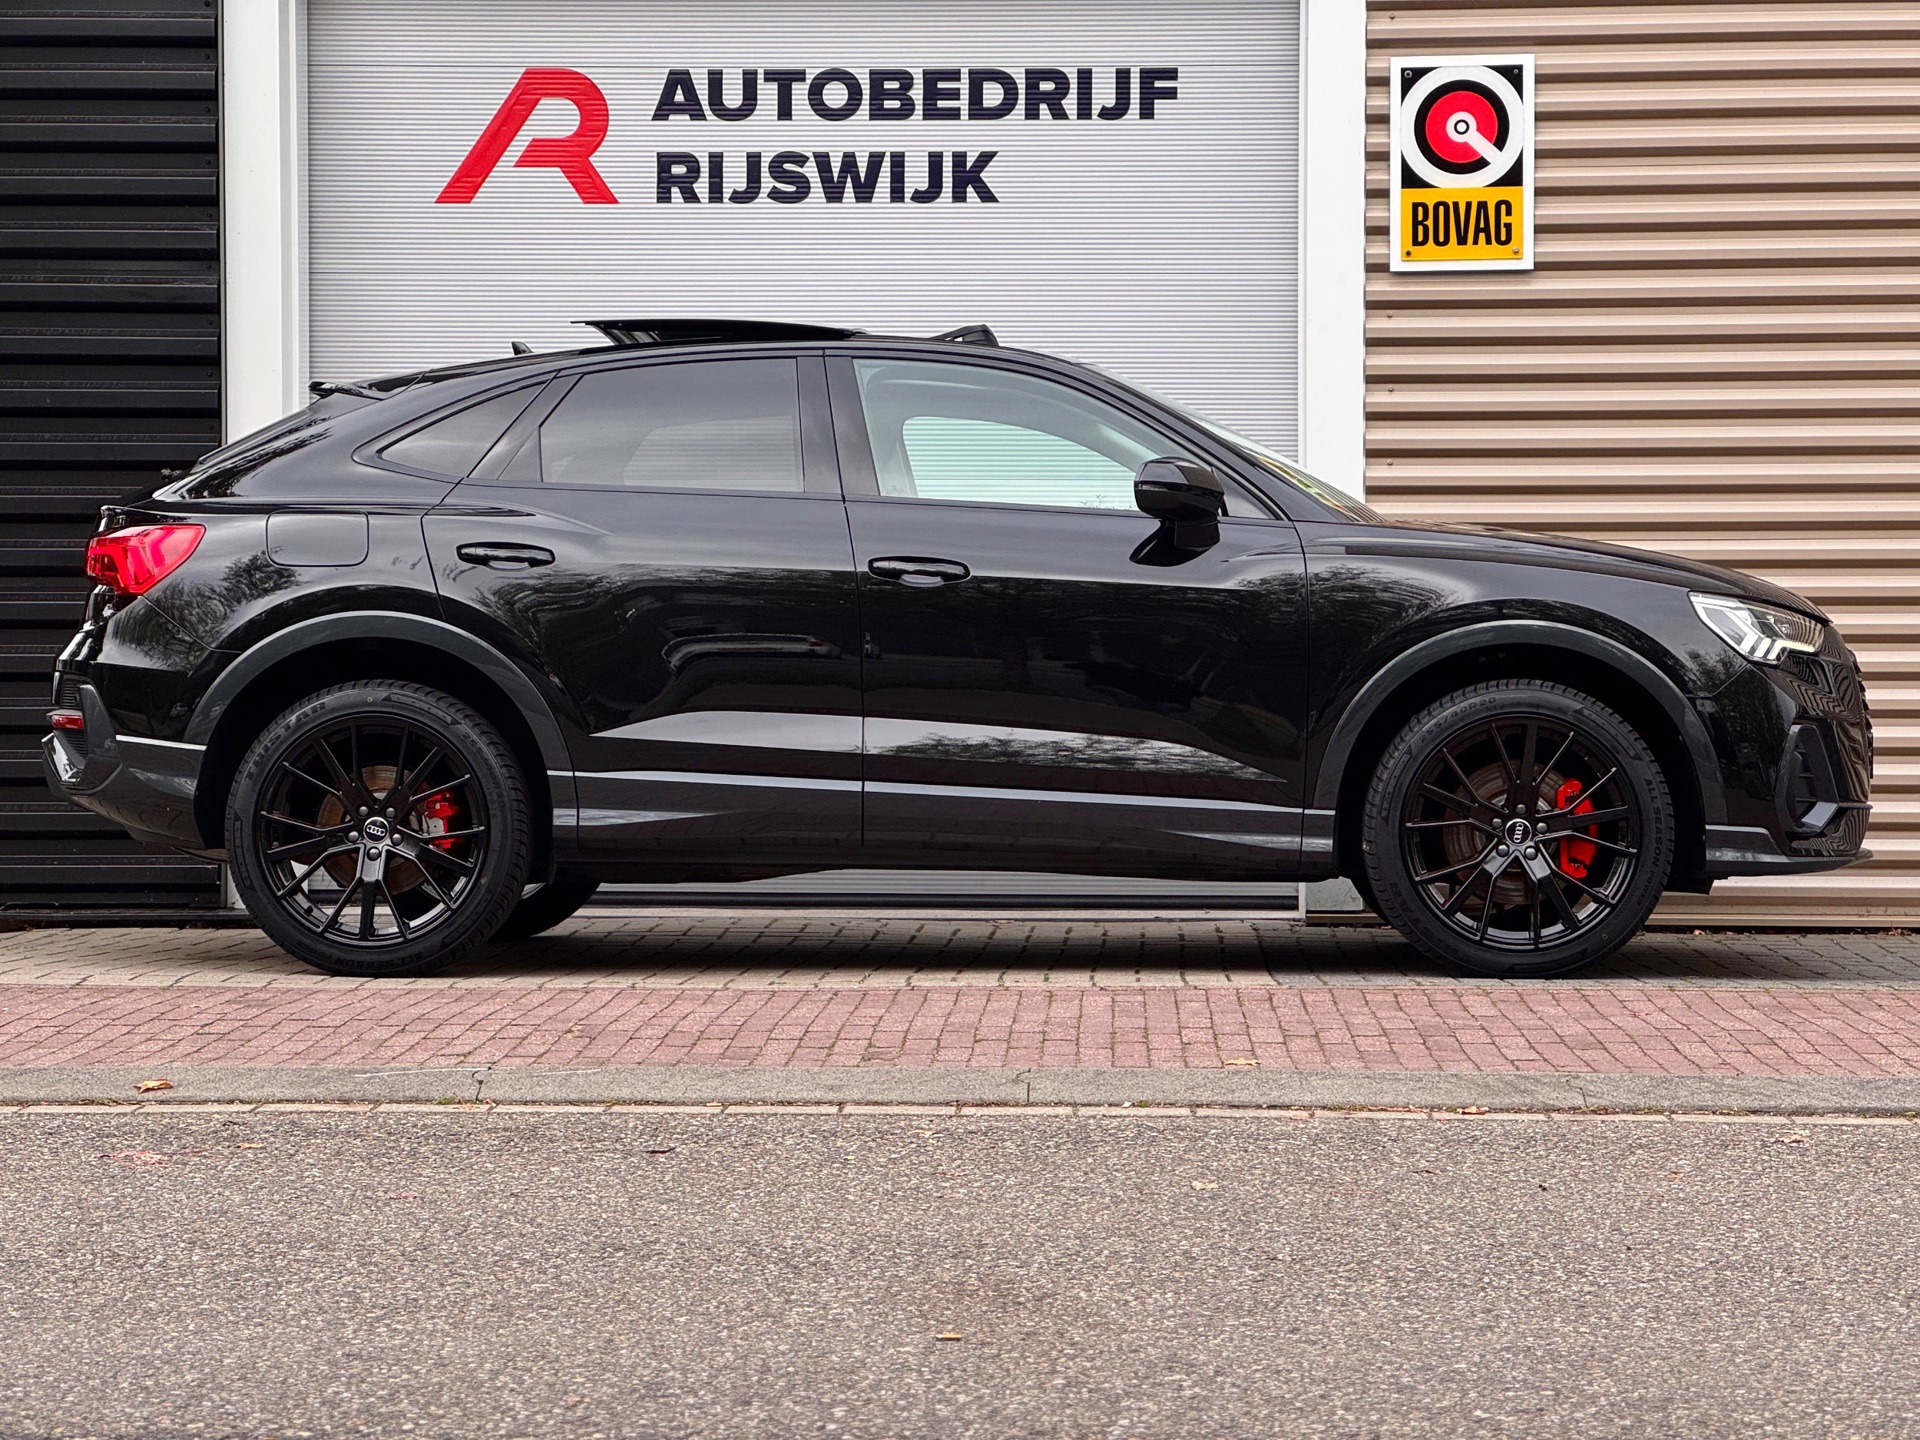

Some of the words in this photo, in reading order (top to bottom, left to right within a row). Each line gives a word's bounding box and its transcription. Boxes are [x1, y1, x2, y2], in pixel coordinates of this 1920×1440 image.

[651, 67, 1179, 121] AUTOBEDRIJF
[656, 151, 1001, 204] RIJSWIJK
[1411, 199, 1513, 247] BOVAG
[244, 700, 326, 781] TRISTAR
[1418, 697, 1496, 742] 255/40R20
[1643, 776, 1657, 803] ALL
[1651, 805, 1662, 867] SEASON
